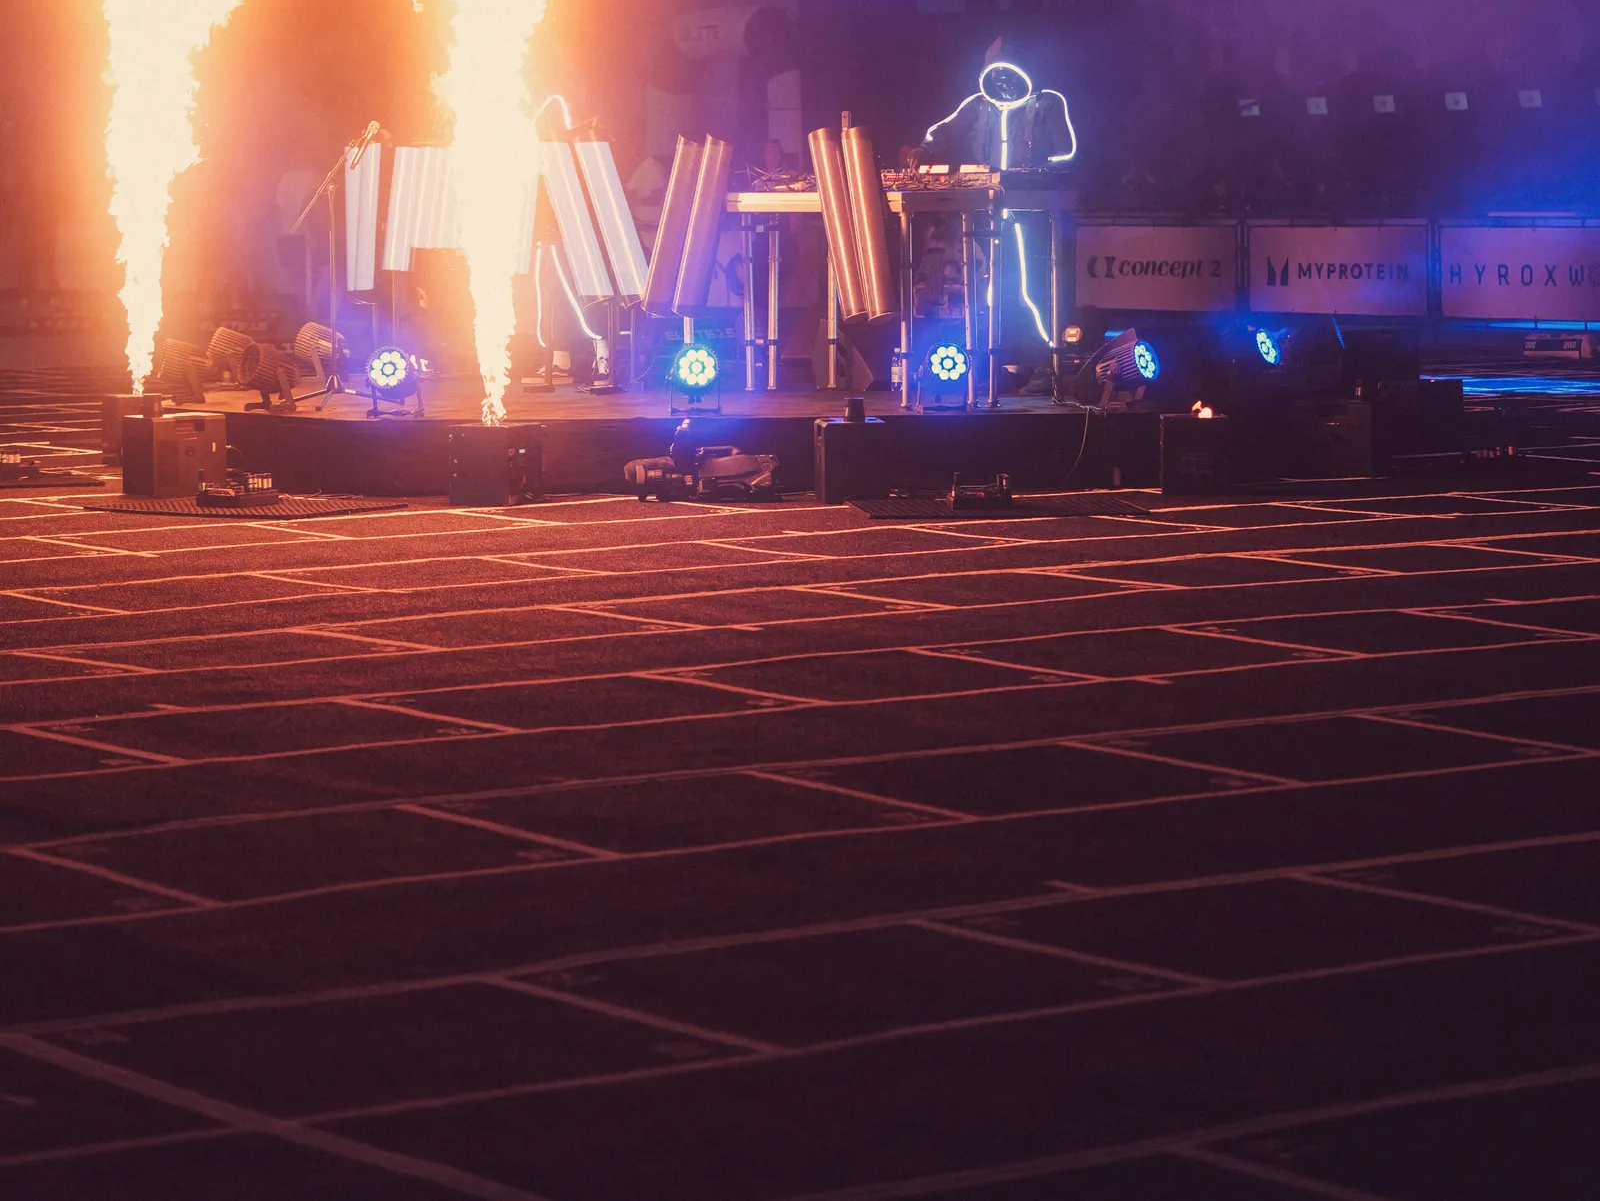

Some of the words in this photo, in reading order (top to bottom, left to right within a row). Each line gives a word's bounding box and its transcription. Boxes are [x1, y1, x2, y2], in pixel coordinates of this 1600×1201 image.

[1118, 258, 1203, 279] concept
[1210, 259, 1222, 278] 2
[1297, 262, 1409, 280] MYPROTEIN
[1450, 263, 1557, 287] HYROX
